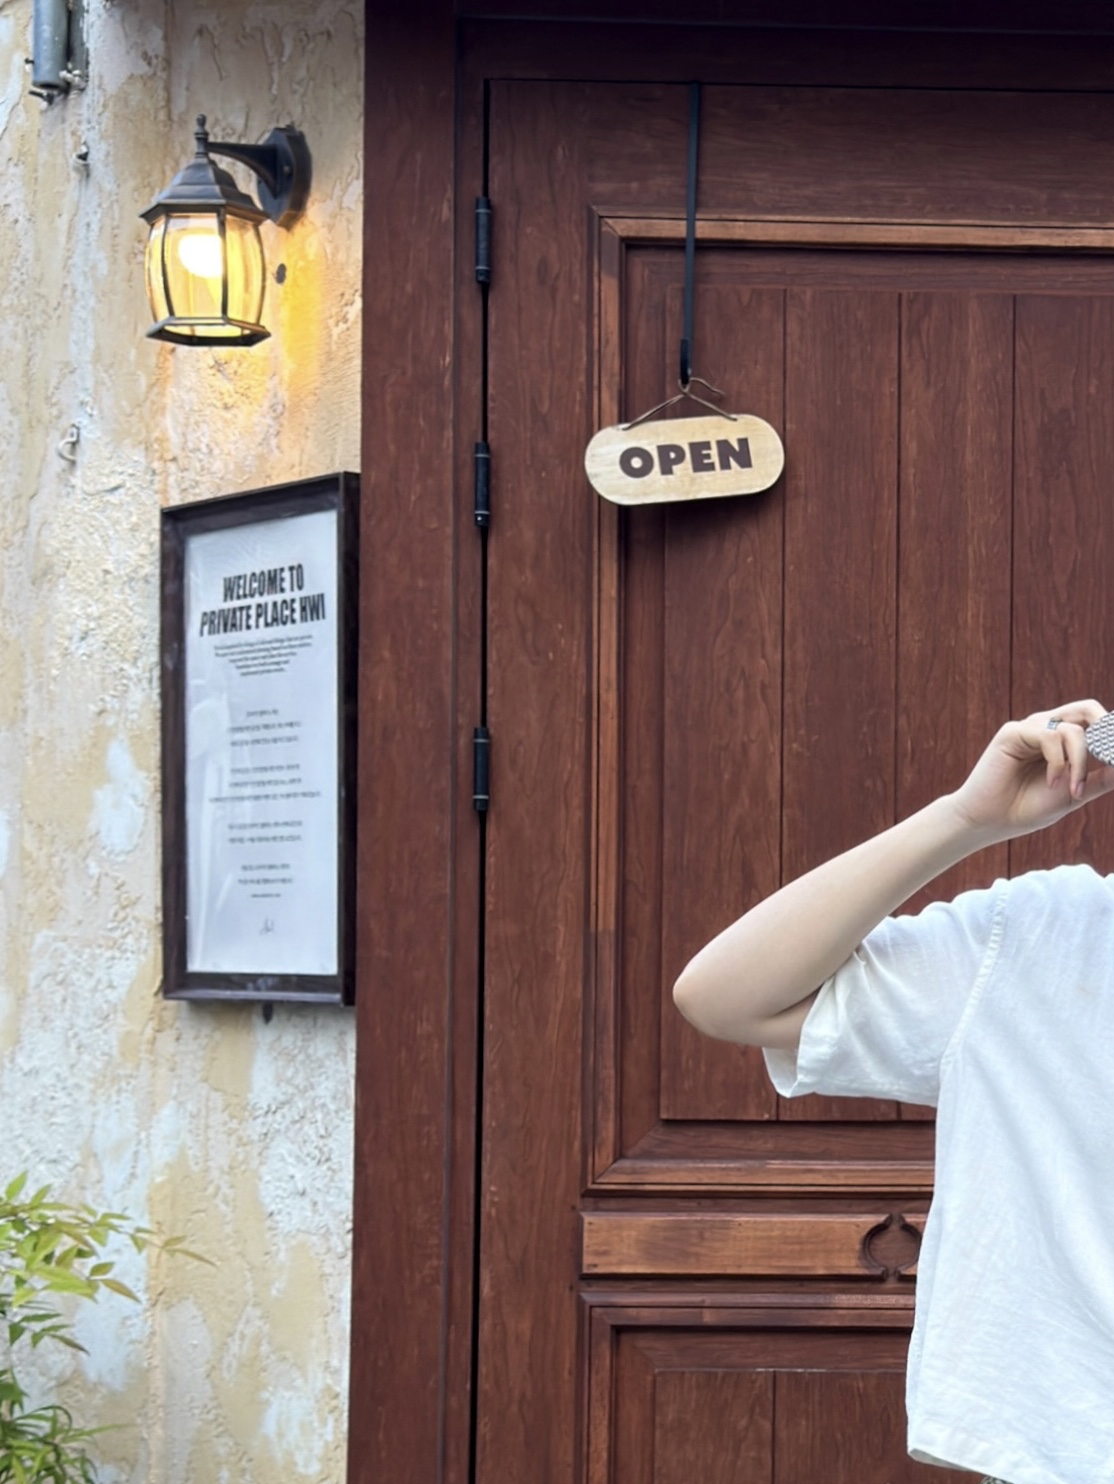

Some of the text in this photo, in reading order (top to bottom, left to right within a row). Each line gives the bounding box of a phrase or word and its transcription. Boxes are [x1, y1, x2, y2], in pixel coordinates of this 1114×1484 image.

[619, 437, 753, 478] OPEN
[223, 563, 304, 602] WELCOME TO
[199, 604, 252, 637] PRIVATE
[255, 598, 296, 629] PLACE
